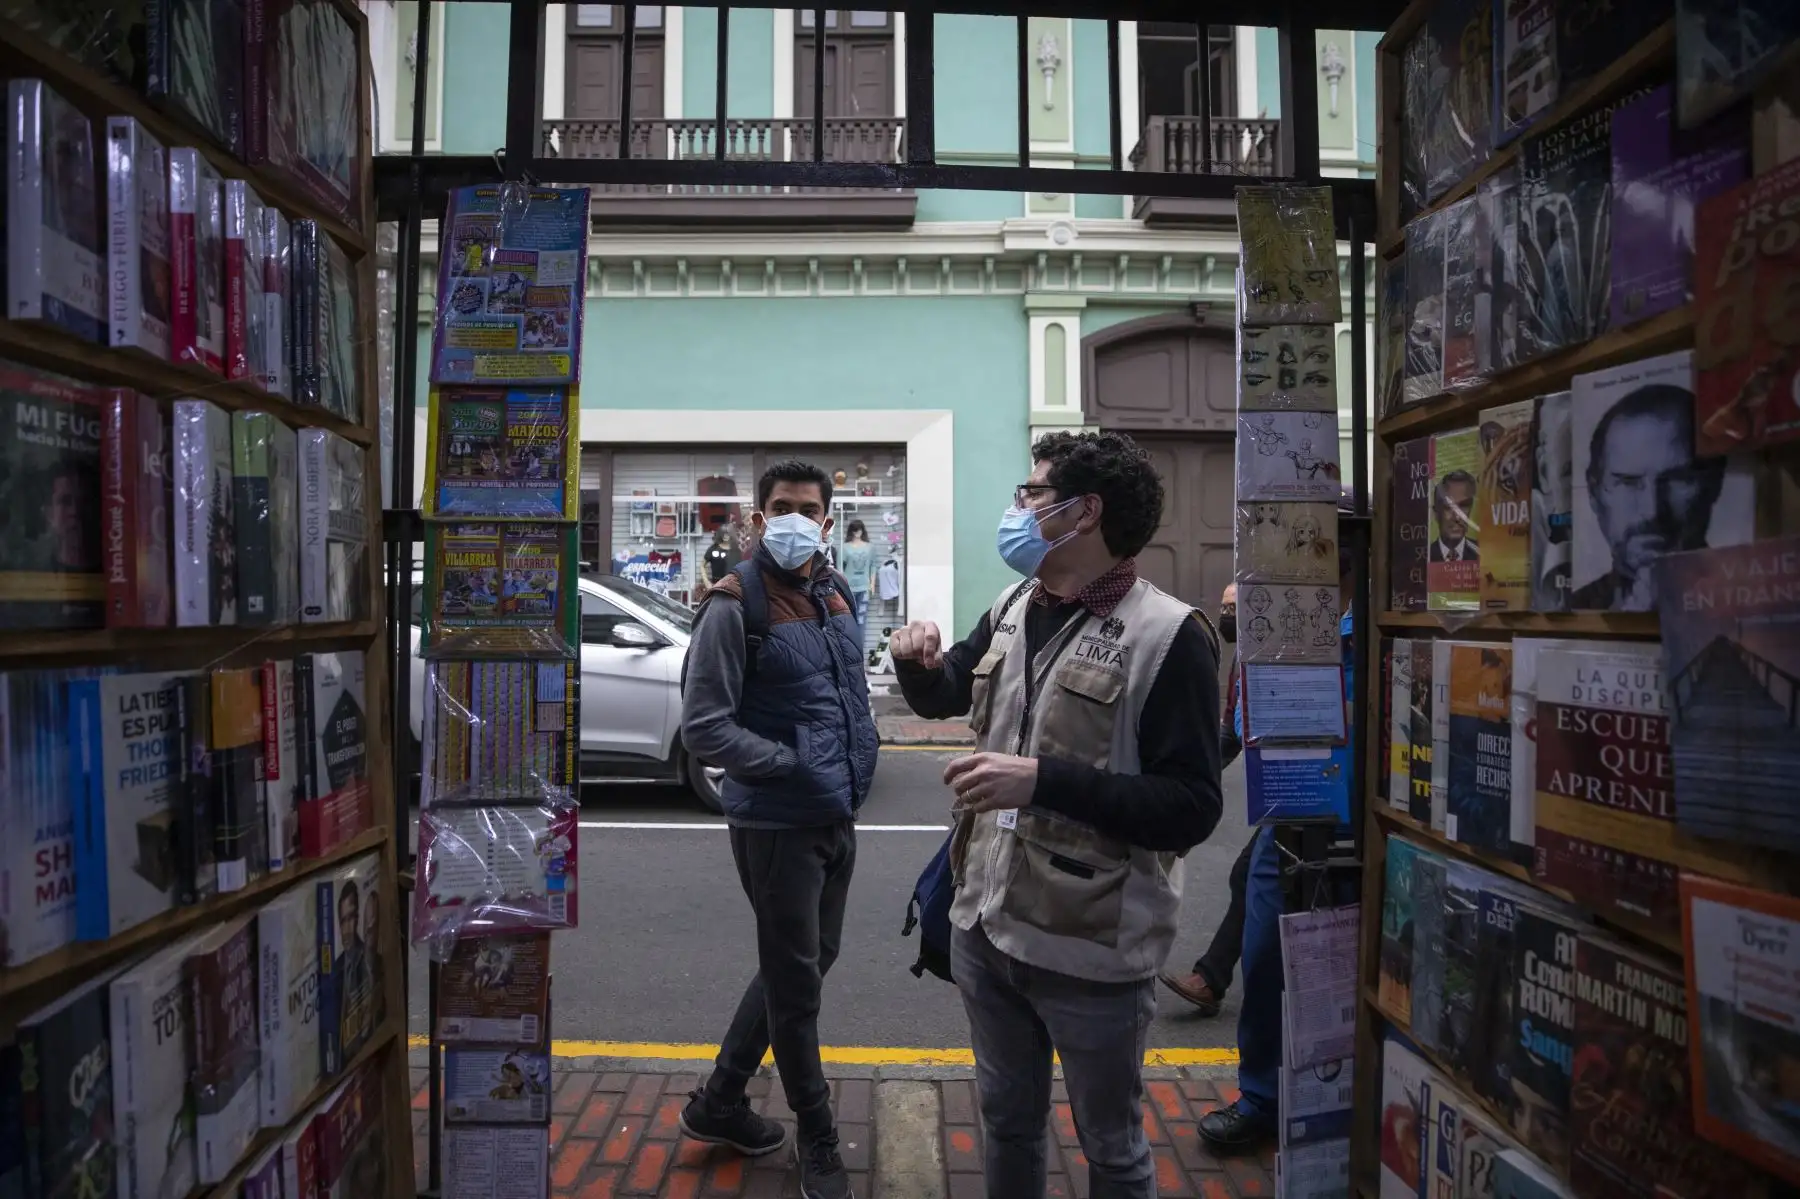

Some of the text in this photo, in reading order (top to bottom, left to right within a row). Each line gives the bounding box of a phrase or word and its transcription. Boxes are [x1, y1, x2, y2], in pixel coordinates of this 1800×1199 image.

[116, 210, 128, 256] FURIA
[116, 270, 128, 322] FUEGO
[16, 402, 49, 429] MI
[507, 425, 560, 437] MARCOS
[305, 438, 321, 547] NORA ROBERTS
[1491, 500, 1529, 526] VIDA
[445, 552, 497, 567] VILLARREAL
[627, 560, 671, 576] especial
[1075, 643, 1122, 668] LIMA
[1576, 667, 1603, 686] LA
[119, 694, 140, 714] LA
[1478, 690, 1504, 710] Martha
[122, 718, 146, 738] ES
[1576, 970, 1648, 1029] MARTÍN
